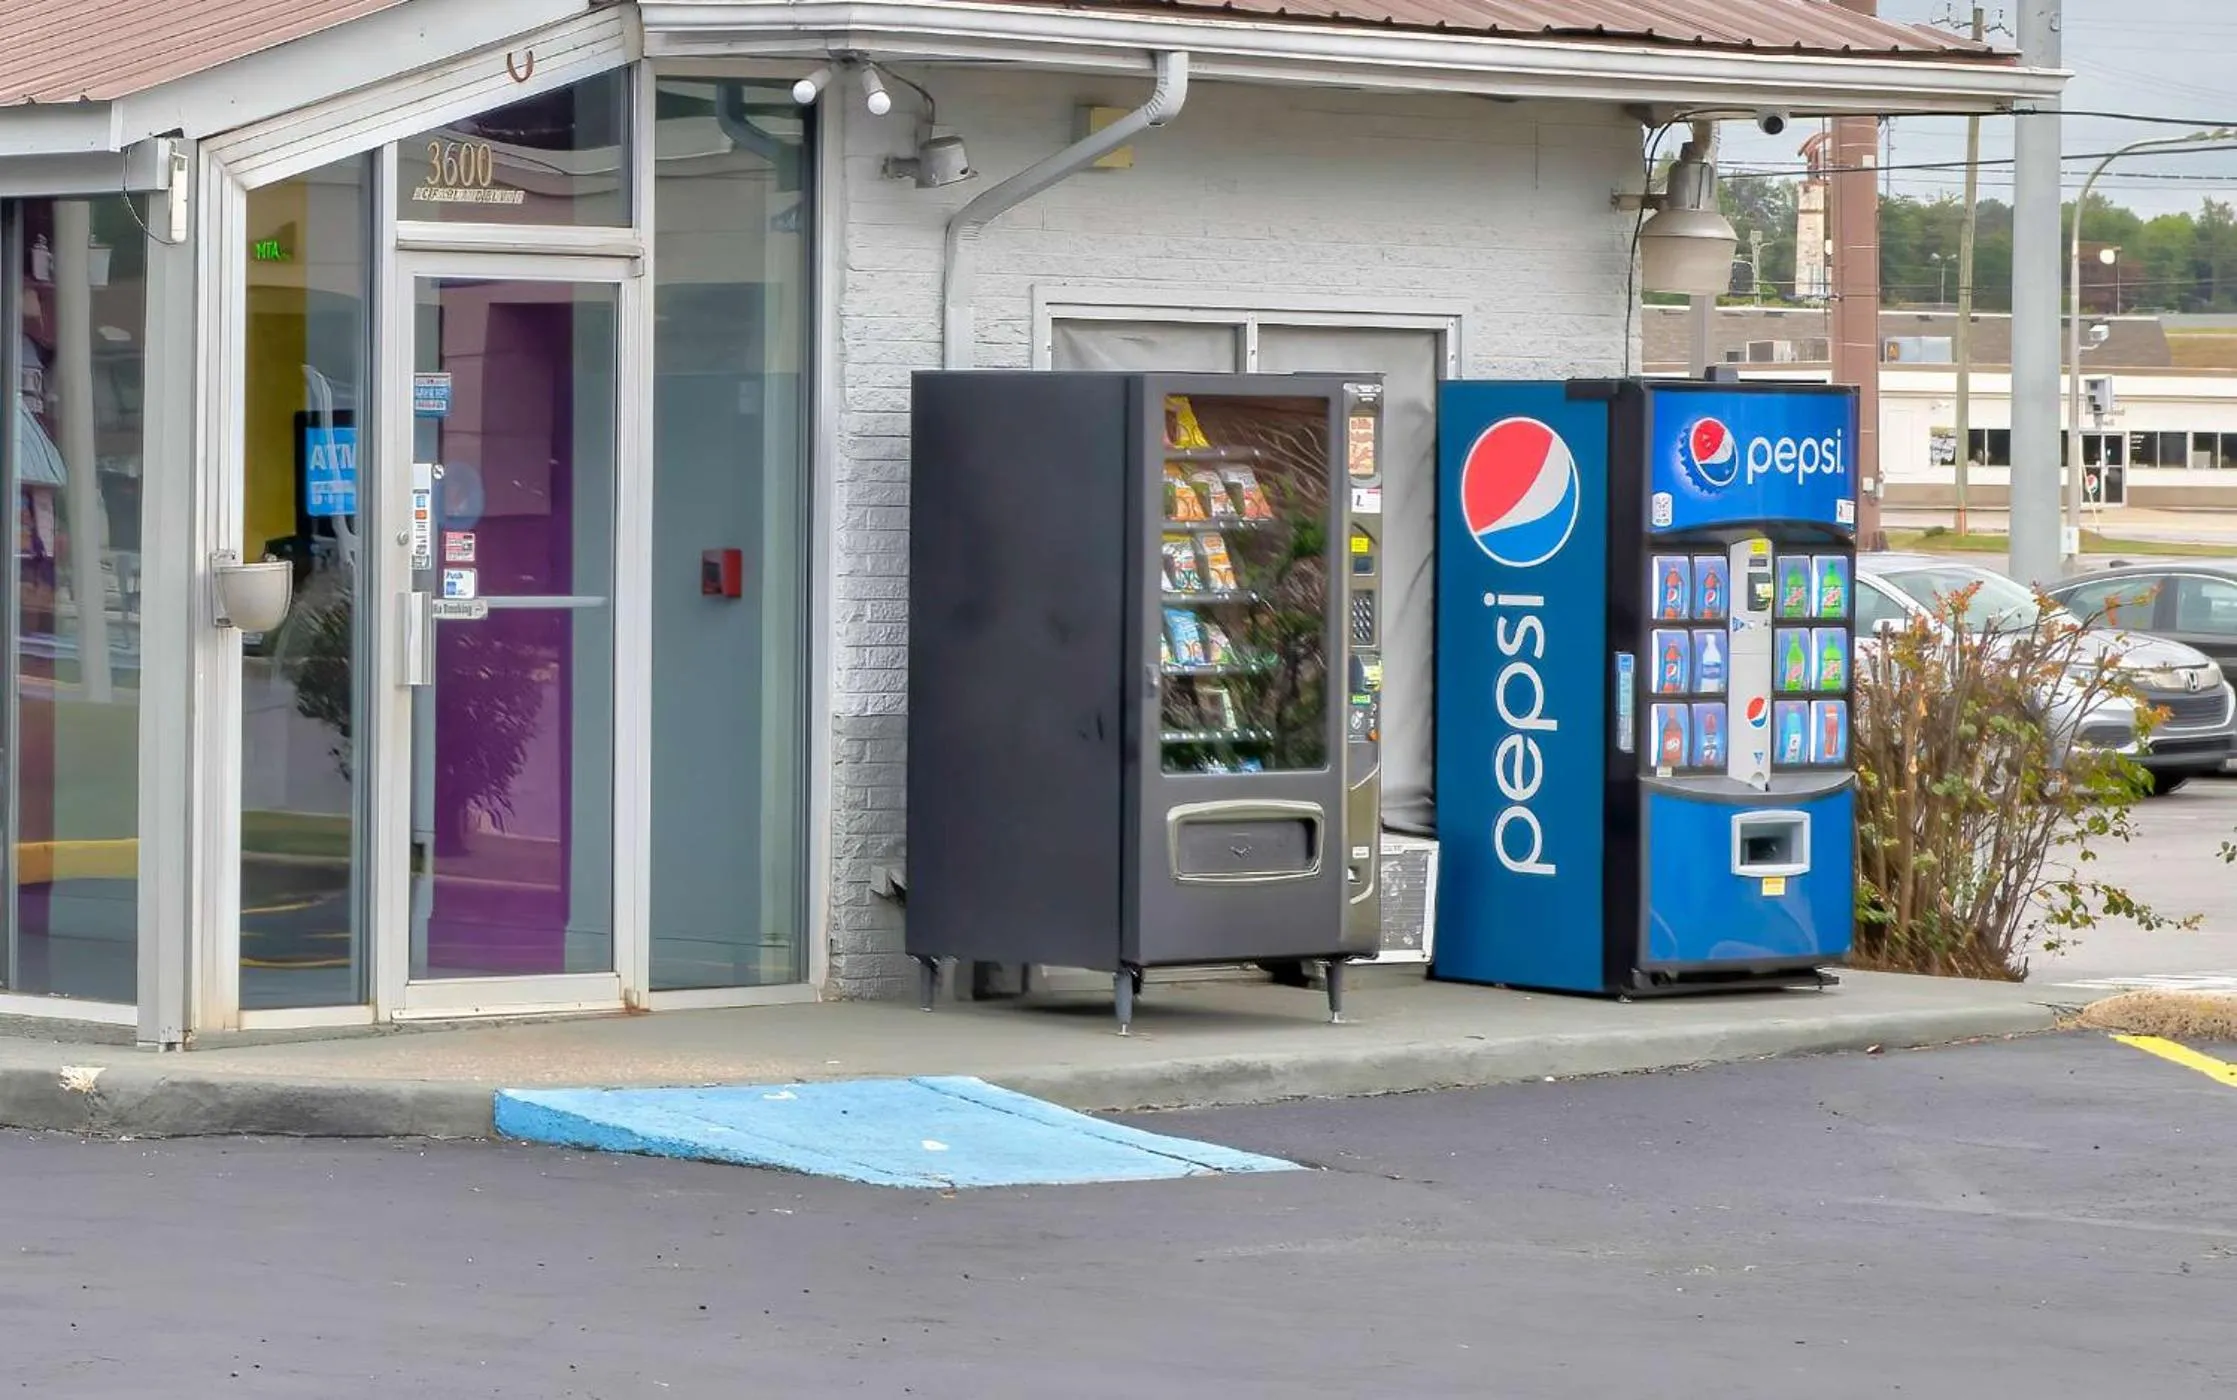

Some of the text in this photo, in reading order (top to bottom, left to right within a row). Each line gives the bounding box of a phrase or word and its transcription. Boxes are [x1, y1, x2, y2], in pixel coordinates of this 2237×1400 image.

[425, 141, 492, 187] 3600
[1747, 428, 1842, 485] pepsi
[1483, 592, 1558, 875] pepsi
